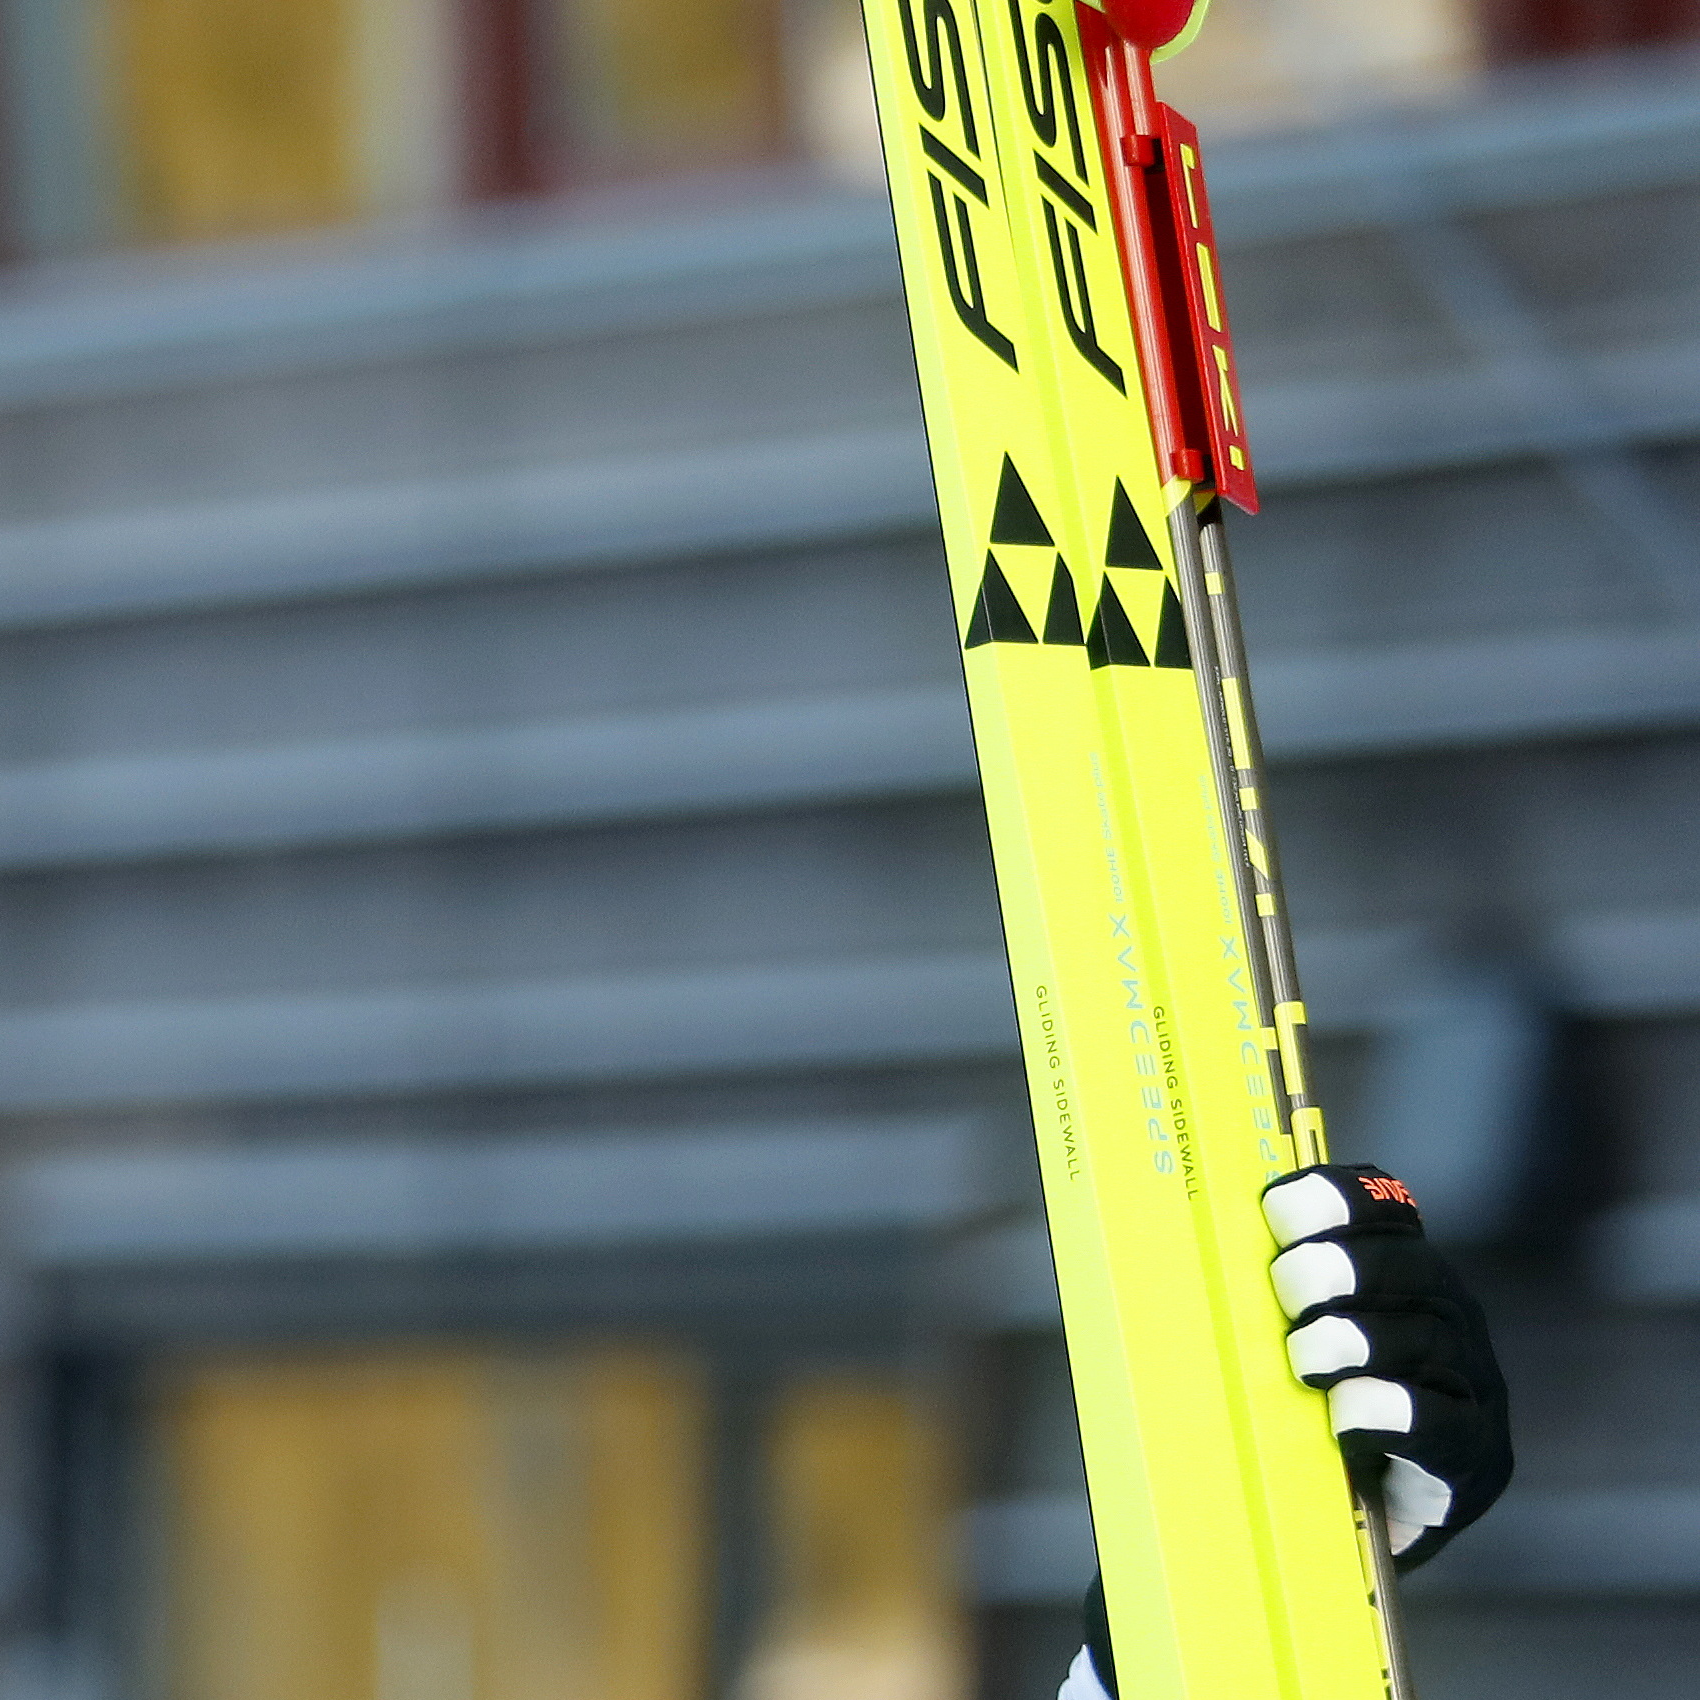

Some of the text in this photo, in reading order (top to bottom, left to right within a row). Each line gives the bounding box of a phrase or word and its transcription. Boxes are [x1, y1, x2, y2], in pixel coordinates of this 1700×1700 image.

[1036, 985, 1080, 1181] GLIDING SIDEWALL
[1153, 1006, 1200, 1201] GLIDING SIDEWALL
